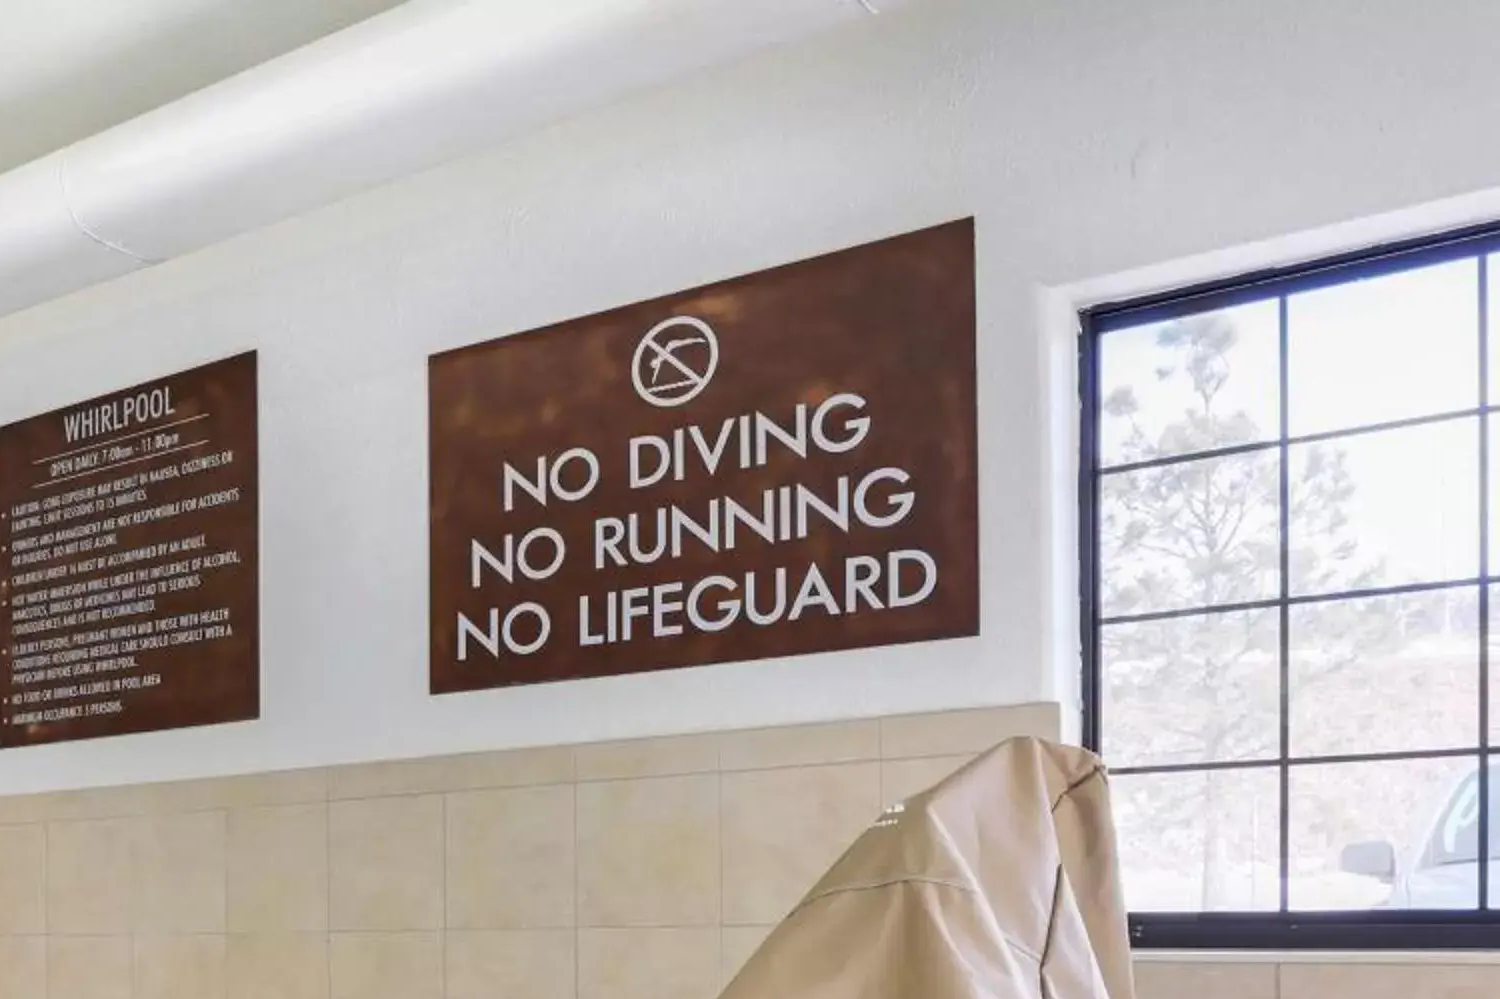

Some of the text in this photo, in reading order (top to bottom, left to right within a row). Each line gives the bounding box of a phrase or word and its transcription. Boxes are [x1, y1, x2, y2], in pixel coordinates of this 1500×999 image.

[50, 458, 72, 477] OPEN
[64, 386, 176, 443] WHIRLPOOL
[503, 393, 870, 512] NO DIVING
[471, 467, 915, 587] NO RUNNING
[456, 549, 937, 661] NO LIFEGUARD
